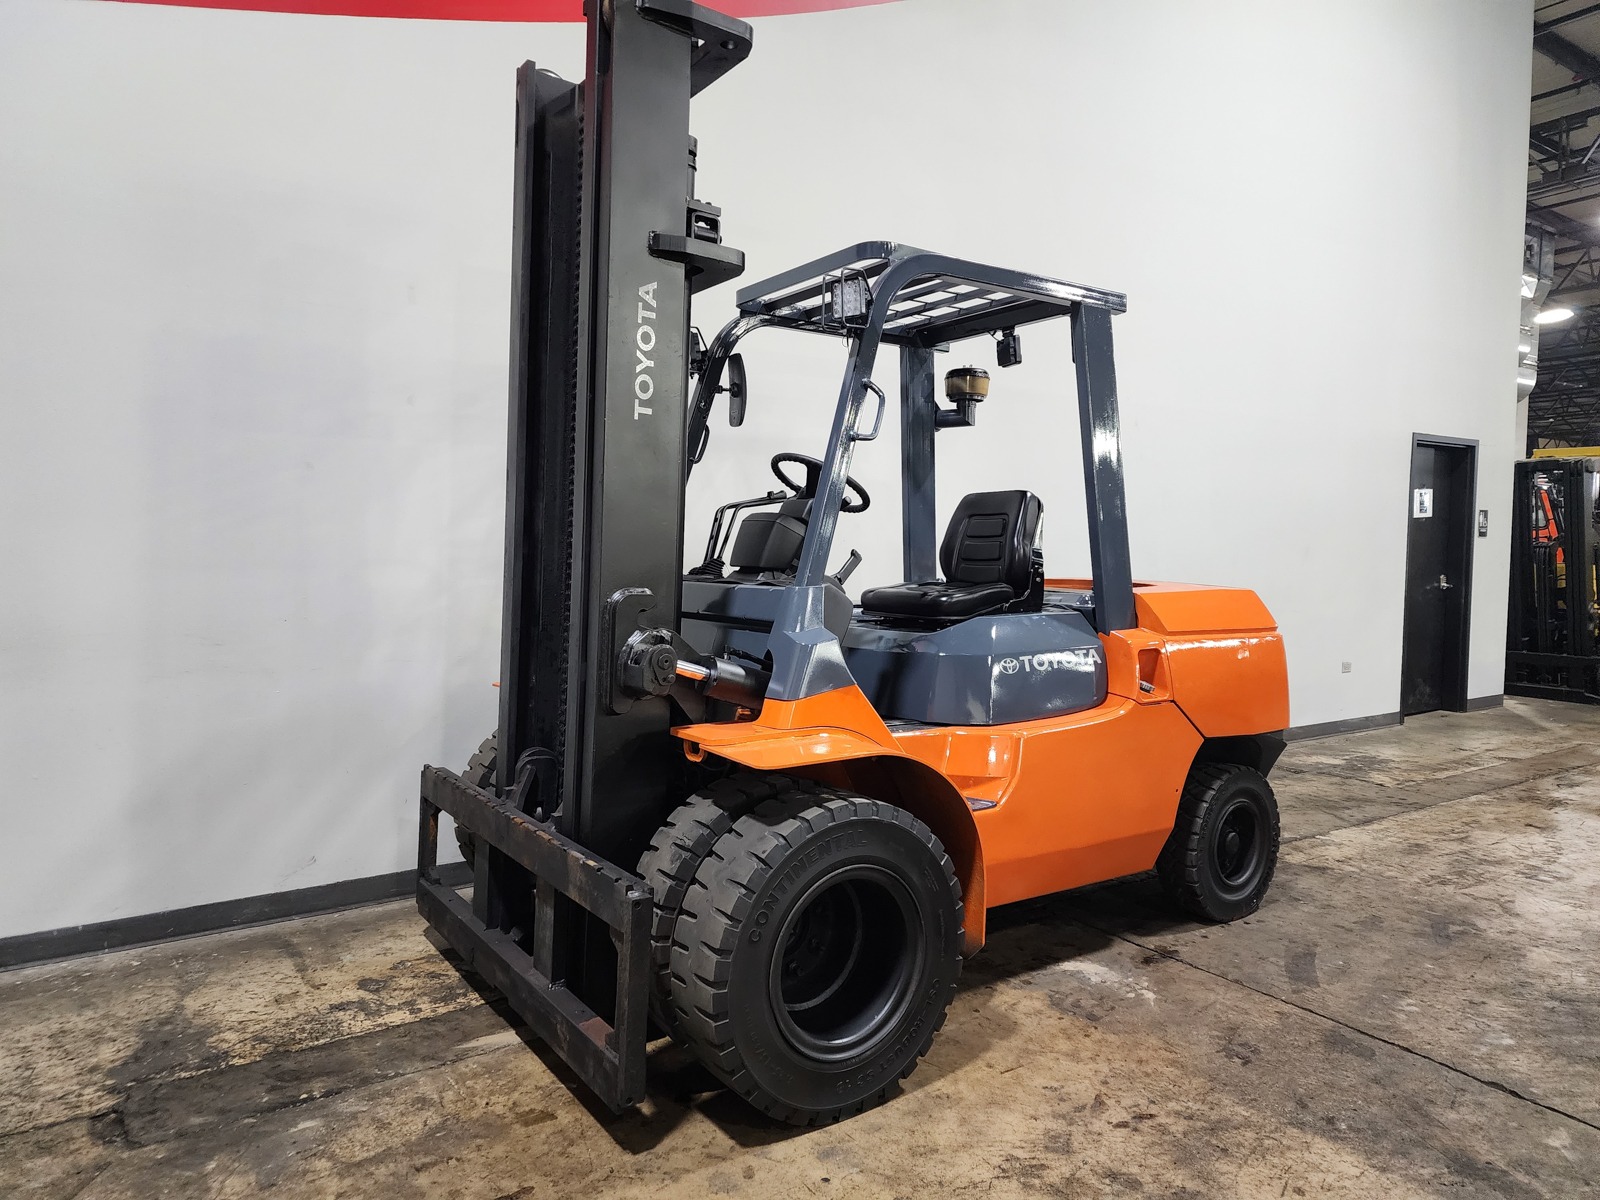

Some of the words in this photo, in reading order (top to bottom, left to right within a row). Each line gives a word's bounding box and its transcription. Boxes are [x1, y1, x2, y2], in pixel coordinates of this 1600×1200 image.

[633, 281, 659, 420] TOYOTA
[1019, 649, 1102, 672] TOYOTA
[748, 829, 868, 944] CONTINENTAL
